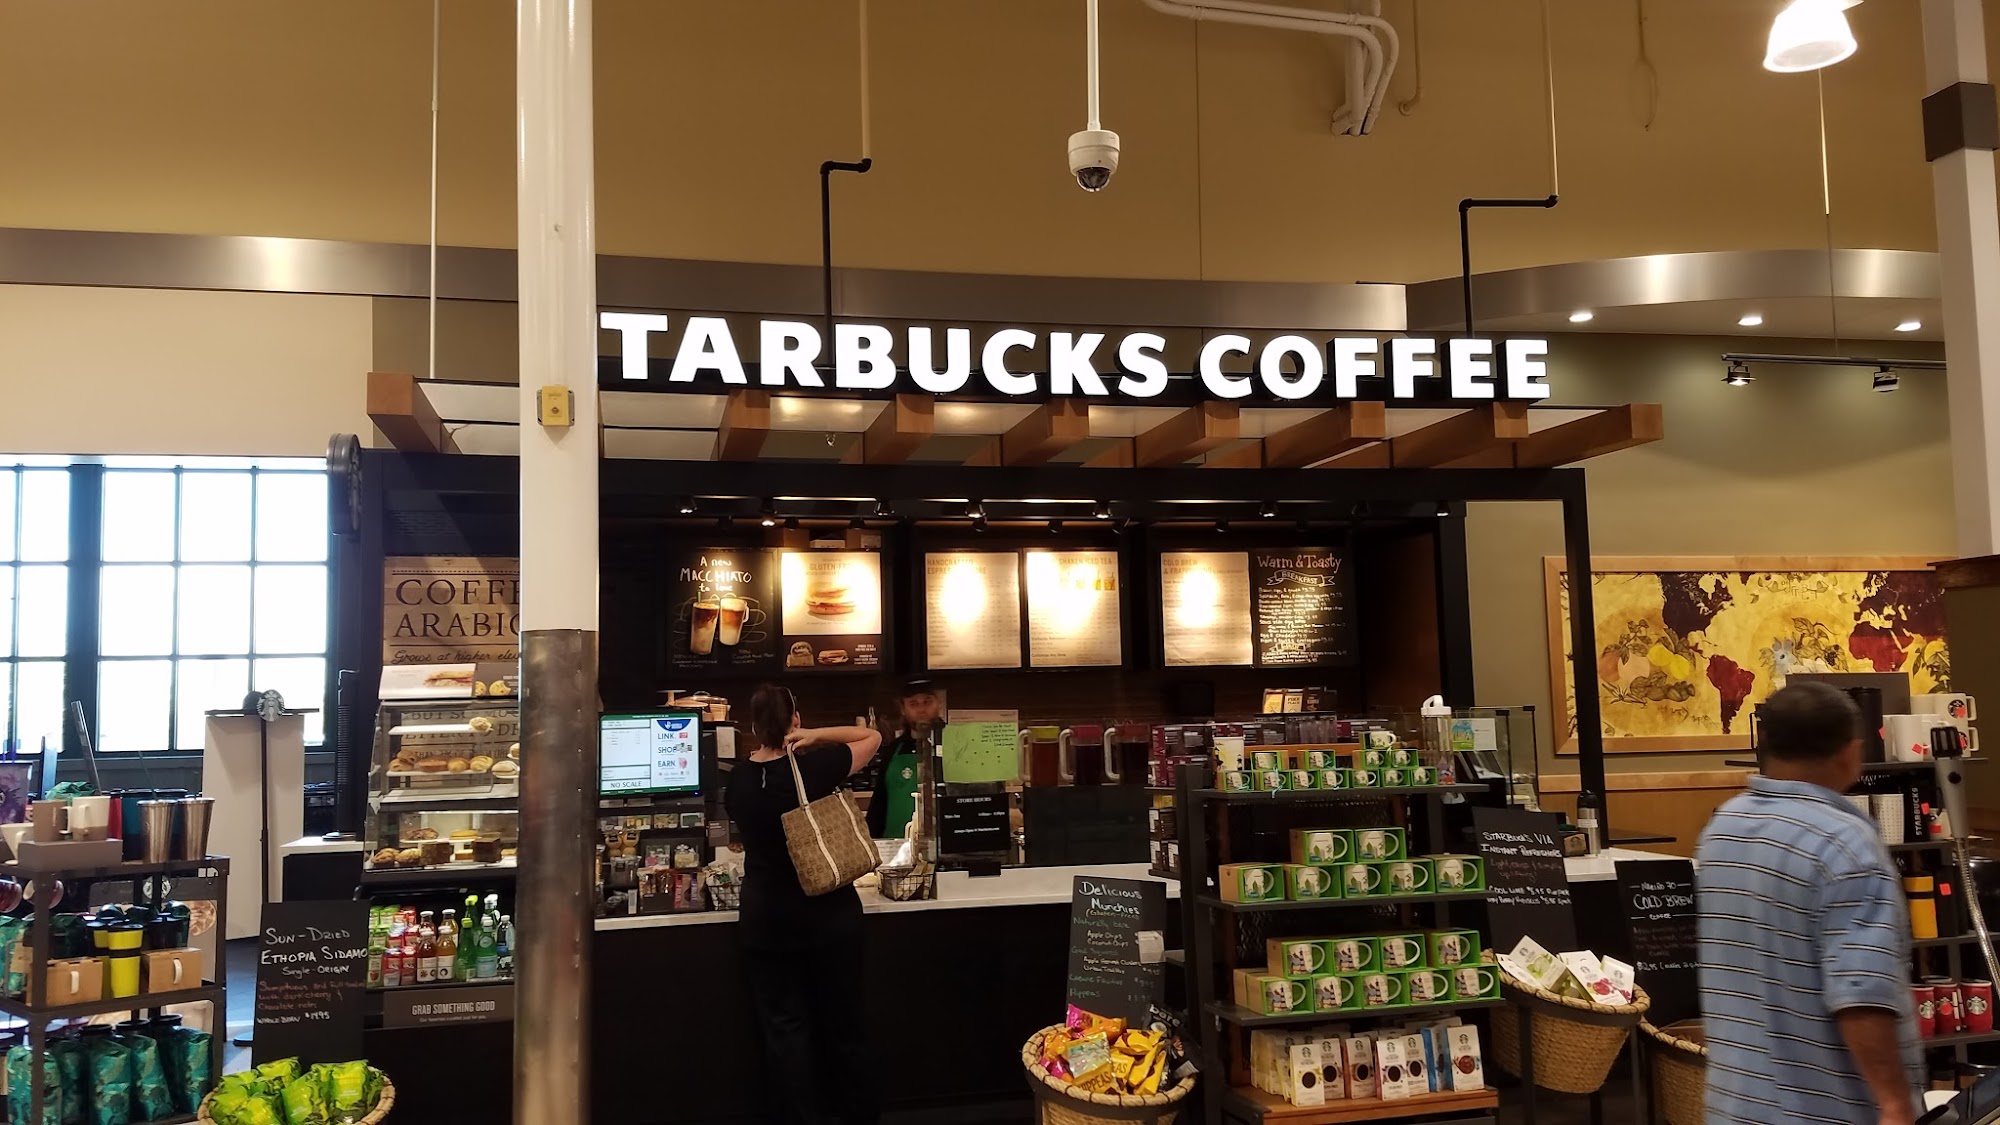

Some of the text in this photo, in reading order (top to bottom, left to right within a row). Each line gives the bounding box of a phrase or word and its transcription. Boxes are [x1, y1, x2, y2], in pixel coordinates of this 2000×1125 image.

[1200, 335, 1551, 399] COFFEE
[700, 555, 708, 567] A
[1257, 552, 1342, 574] Warm & Toasty
[679, 567, 752, 583] MACCHIATO
[1281, 571, 1318, 585] BREAKFAST
[454, 652, 491, 664] higher
[1912, 787, 1922, 835] STARBUCKS
[1533, 833, 1554, 845] VIA
[1079, 881, 1142, 899] Delicious
[1633, 894, 1694, 910] COLD BREW
[321, 946, 368, 960] SIDAMO
[412, 1000, 495, 1016] GRAB SOMETHING GOOD
[1149, 1004, 1181, 1028] bare
